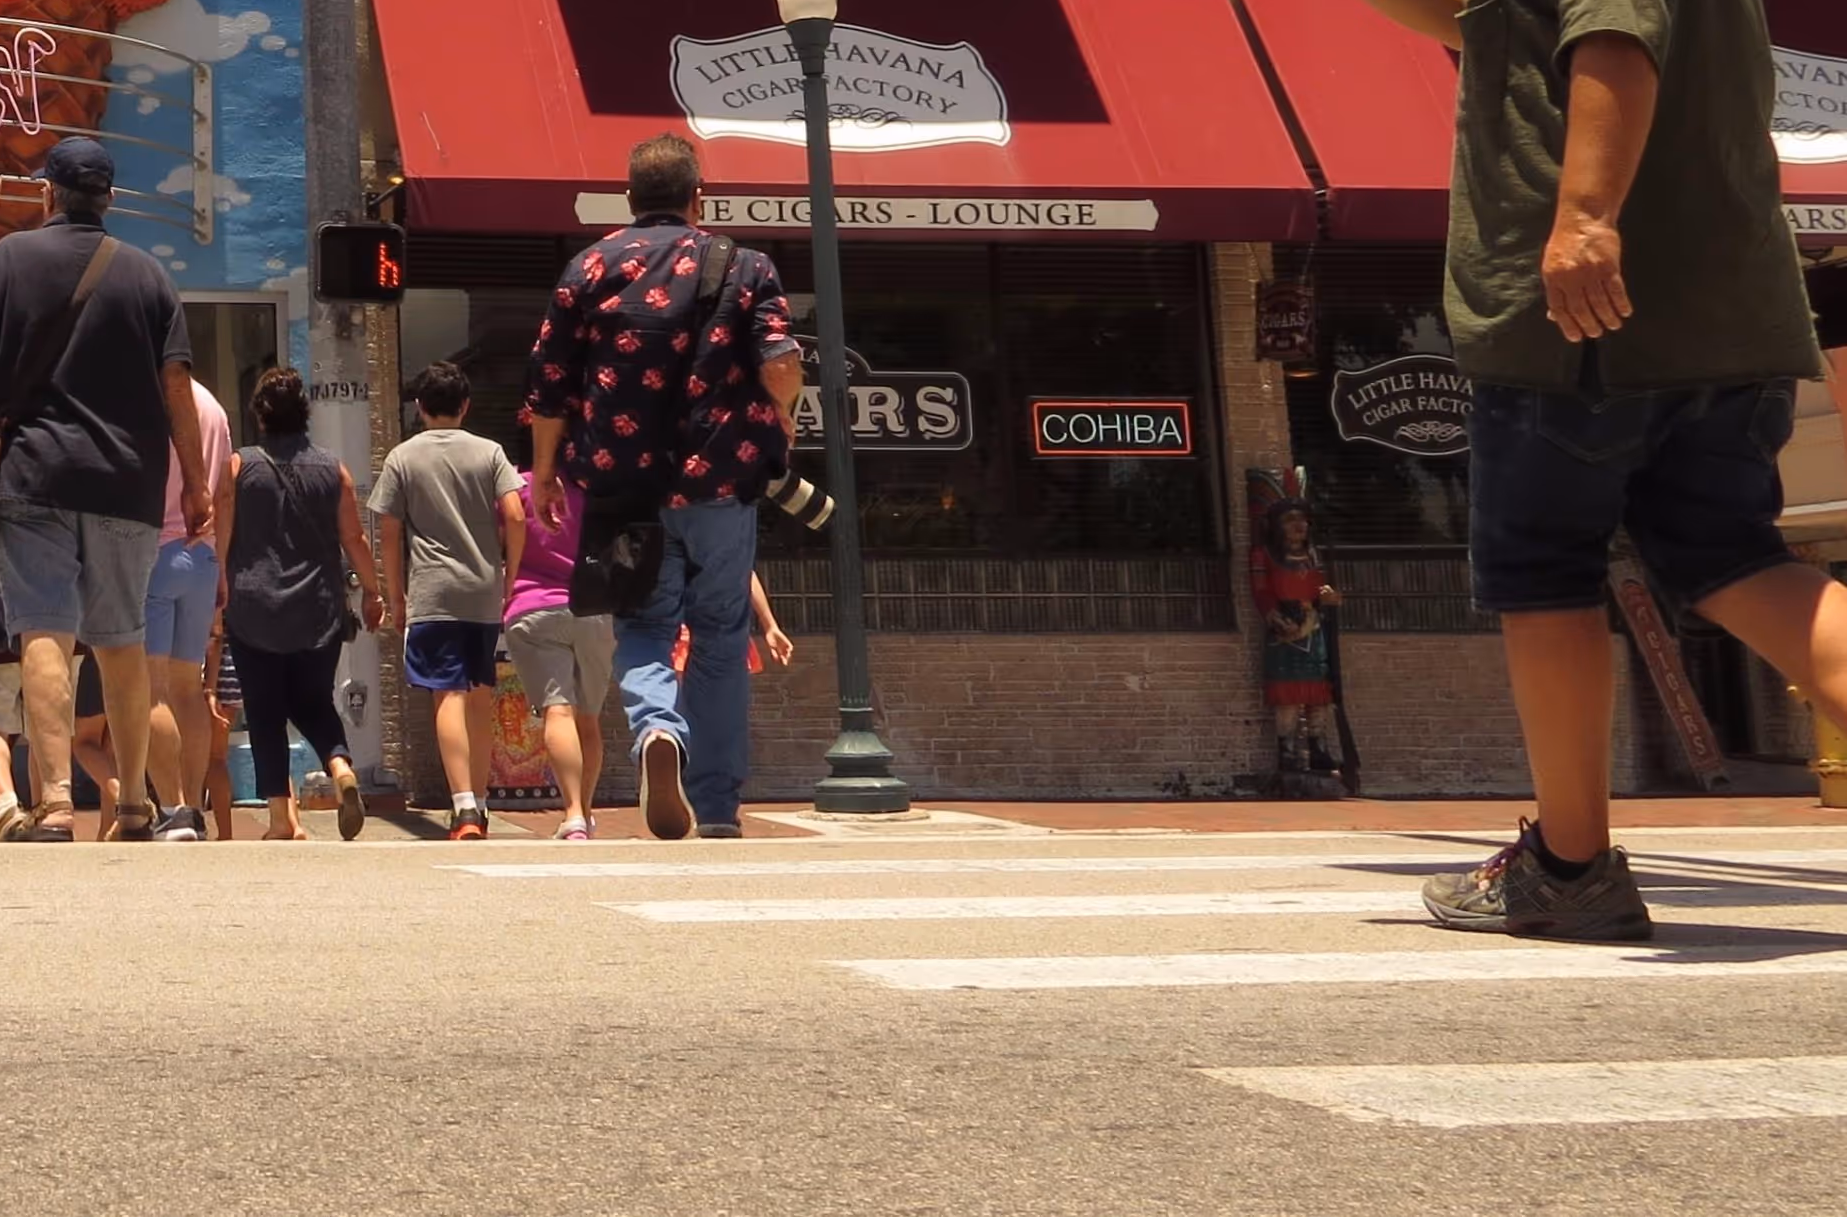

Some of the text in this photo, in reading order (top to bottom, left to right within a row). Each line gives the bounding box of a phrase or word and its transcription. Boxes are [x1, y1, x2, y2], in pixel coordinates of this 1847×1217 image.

[694, 42, 968, 90] LITTLE HAVANA
[722, 74, 958, 116] CIGAR ACTORY
[928, 201, 1097, 227] LOUNGE
[1786, 208, 1847, 230] ARS
[1347, 372, 1474, 410] LITTLE HAVA
[793, 385, 960, 439] ARS
[1362, 395, 1474, 426] CIGAR FACTO
[1042, 413, 1183, 445] COHIBA
